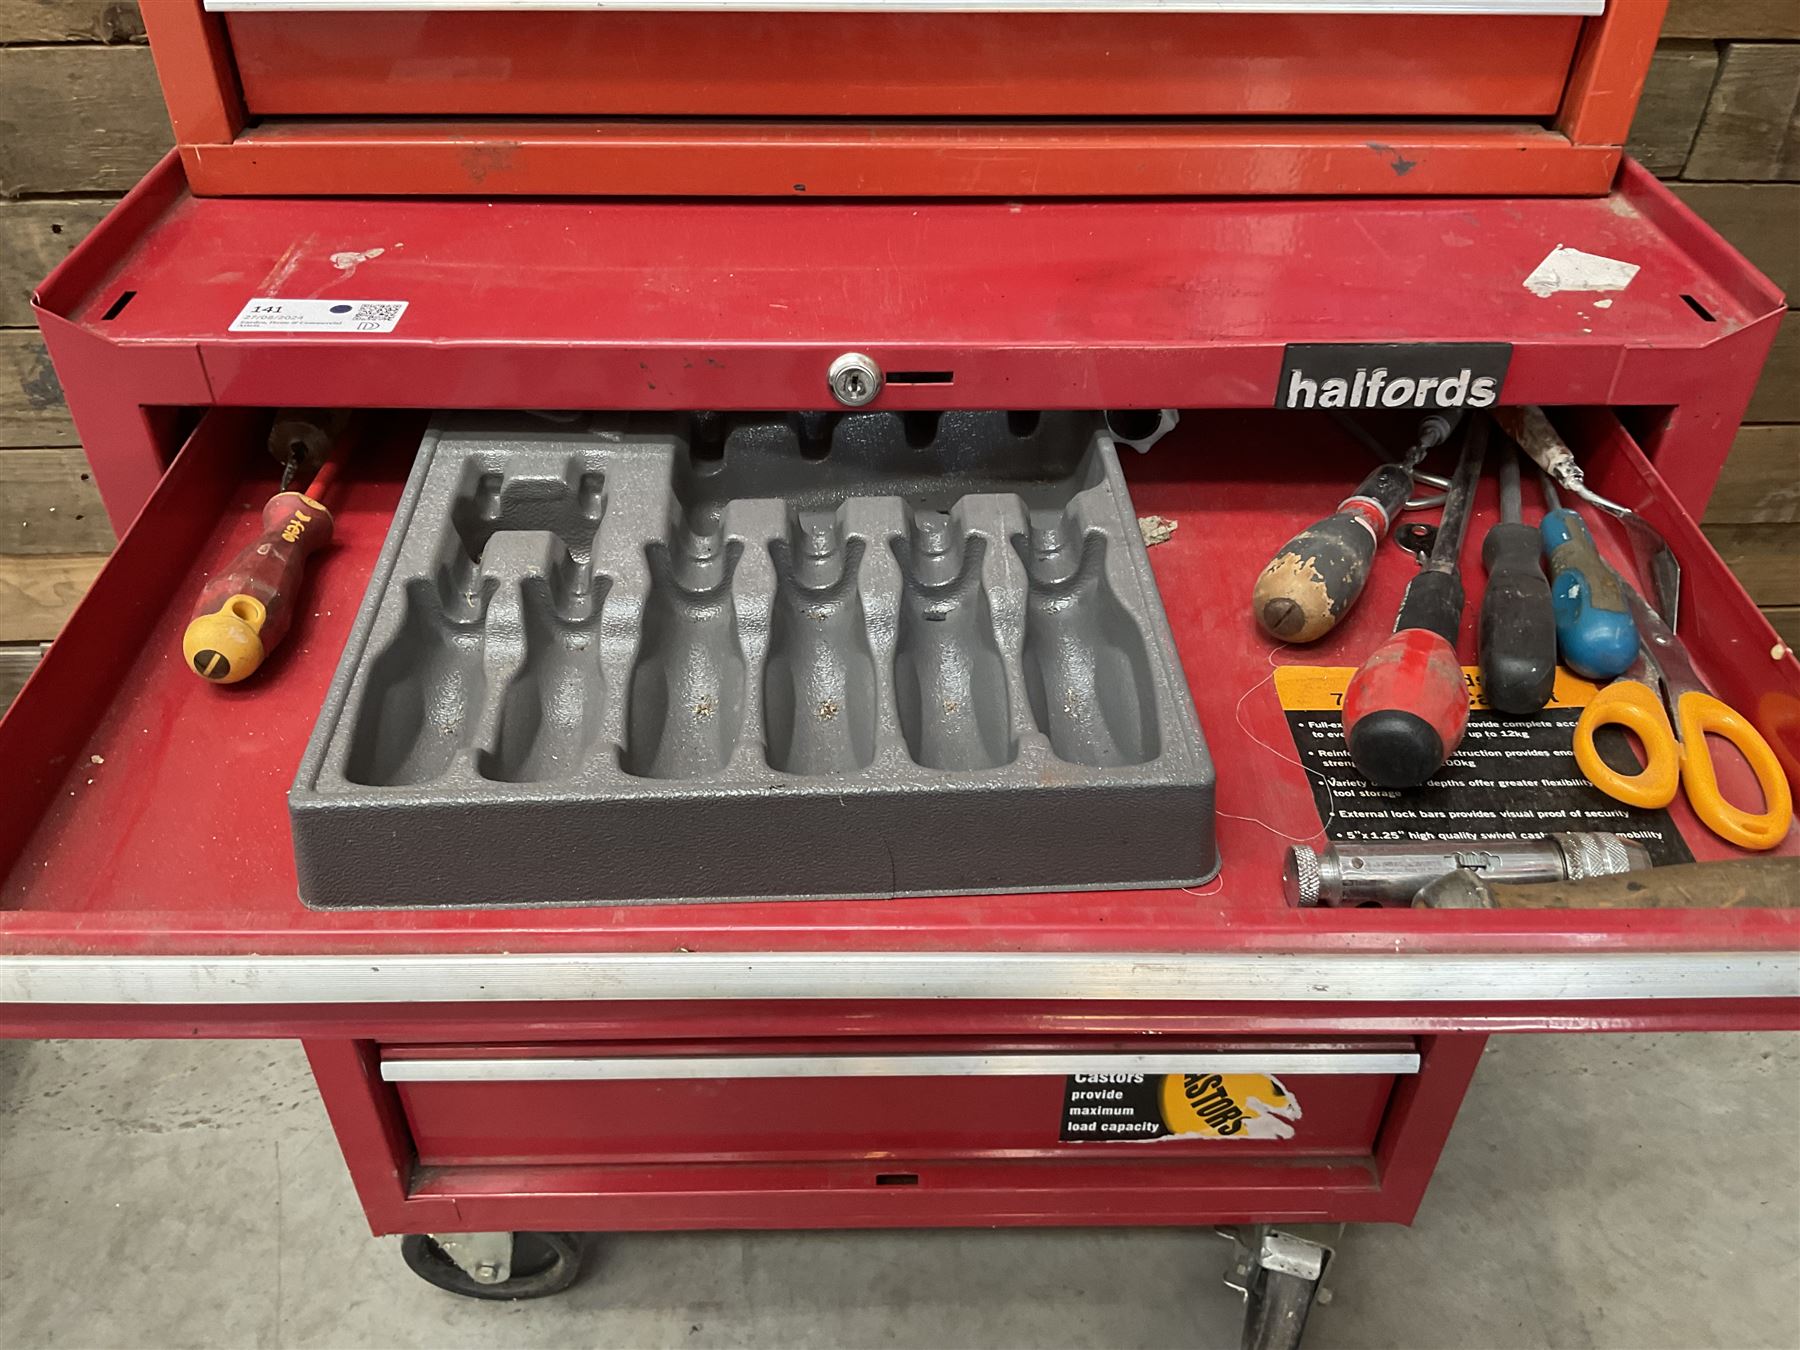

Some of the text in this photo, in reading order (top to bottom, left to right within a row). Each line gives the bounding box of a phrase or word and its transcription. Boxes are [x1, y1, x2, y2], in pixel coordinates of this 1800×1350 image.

[250, 305, 283, 313] 141
[1287, 368, 1497, 408] halfords
[1502, 721, 1553, 729] complete
[1484, 730, 1497, 738] to
[1500, 730, 1531, 738] 12kg
[1317, 749, 1351, 757] Reinf
[1452, 749, 1503, 757] struction
[1504, 749, 1550, 758] provides
[1443, 759, 1477, 767] 00kg
[1327, 779, 1367, 788] Variety
[1426, 779, 1465, 788] depths
[1468, 779, 1495, 787] offer
[1498, 780, 1538, 788] greater
[1541, 779, 1593, 788] flexibility
[1359, 790, 1402, 798] storage
[1338, 810, 1629, 819] External lock bars provides visual proof of security
[1408, 831, 1435, 840] high
[1437, 831, 1477, 840] quality
[1480, 831, 1517, 839] swivel
[1520, 831, 1547, 839] cast
[1615, 831, 1662, 840] mobility
[1074, 1073, 1144, 1083] Castors
[1071, 1089, 1124, 1101] provide
[1184, 1074, 1244, 1135] ASTORS
[1069, 1106, 1134, 1115] maximum
[1067, 1121, 1159, 1133] load capacity
